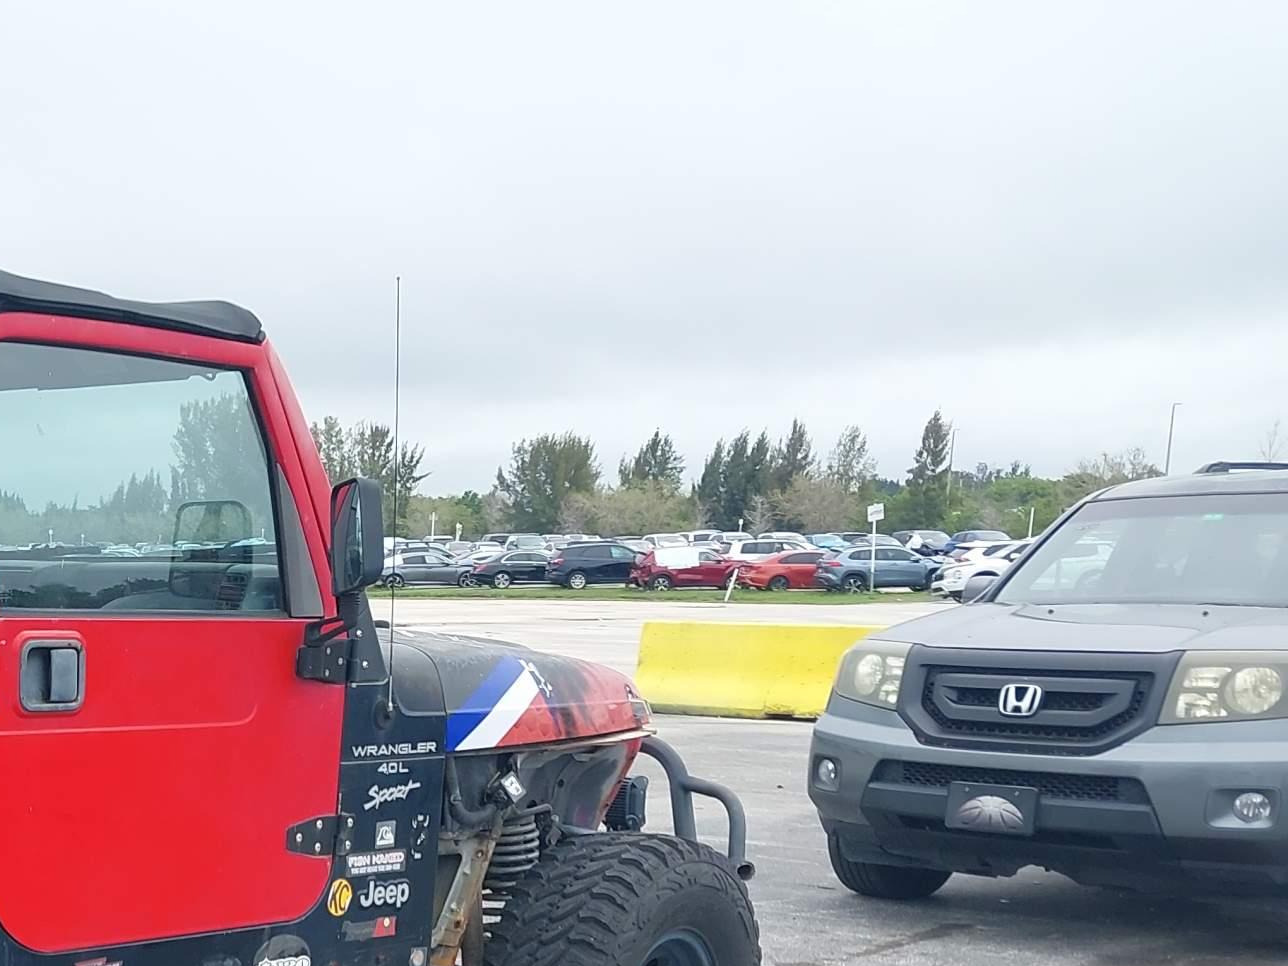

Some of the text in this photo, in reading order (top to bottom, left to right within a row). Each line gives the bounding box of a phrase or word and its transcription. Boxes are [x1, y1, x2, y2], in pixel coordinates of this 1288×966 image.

[352, 741, 436, 758] WRANGLER
[363, 780, 421, 810] Sport
[329, 884, 351, 911] KC
[360, 881, 409, 907] Jeep
